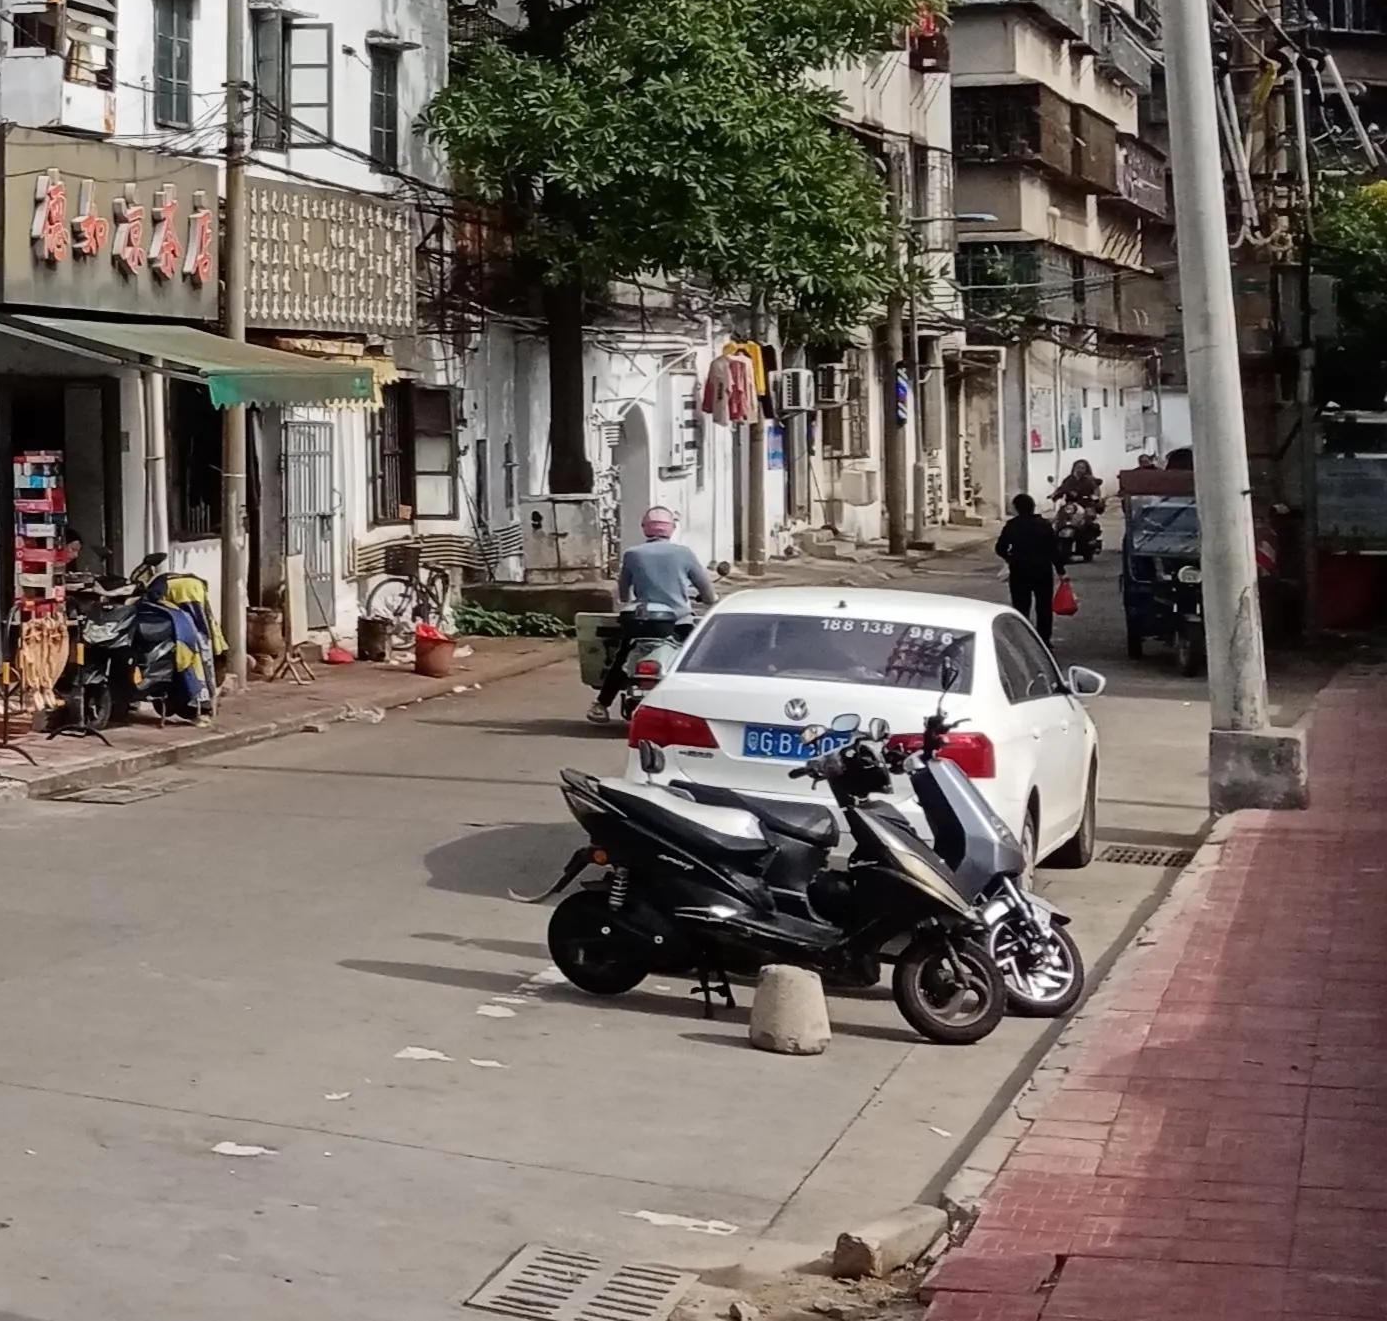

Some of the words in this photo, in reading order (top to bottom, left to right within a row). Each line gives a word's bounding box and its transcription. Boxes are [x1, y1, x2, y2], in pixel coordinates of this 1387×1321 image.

[821, 619, 855, 631] 188
[861, 621, 894, 635] 138
[909, 626, 935, 641] 98
[941, 632, 954, 645] 6
